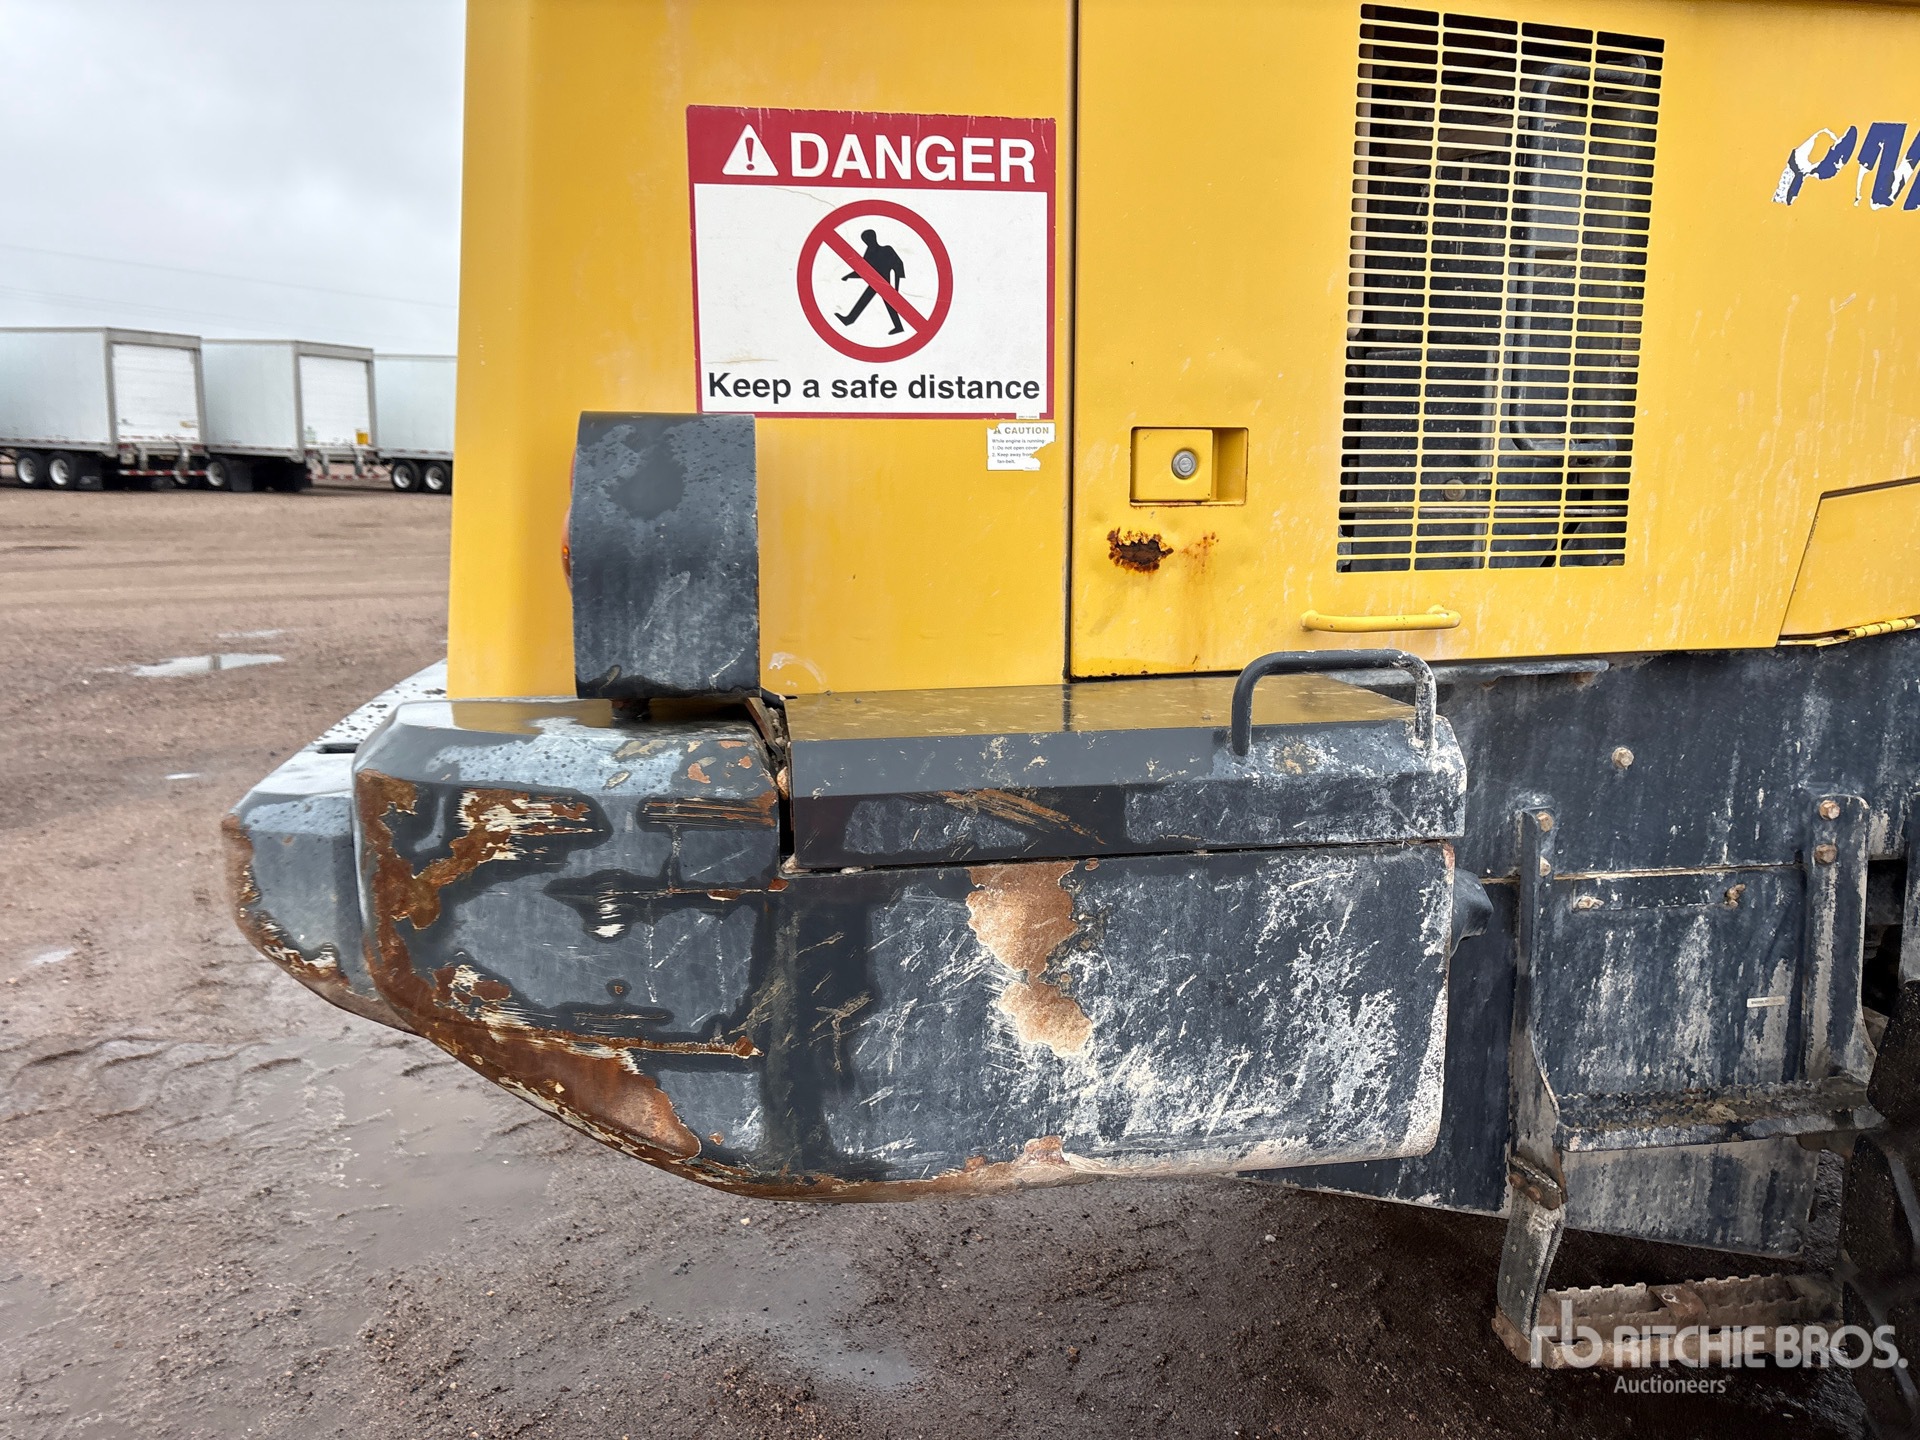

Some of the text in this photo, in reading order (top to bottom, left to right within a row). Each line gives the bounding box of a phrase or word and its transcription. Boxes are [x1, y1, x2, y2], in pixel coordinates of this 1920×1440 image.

[790, 132, 1036, 183] DANGER
[708, 372, 1041, 404] Keep a safe distance
[1004, 426, 1049, 435] CAUTION
